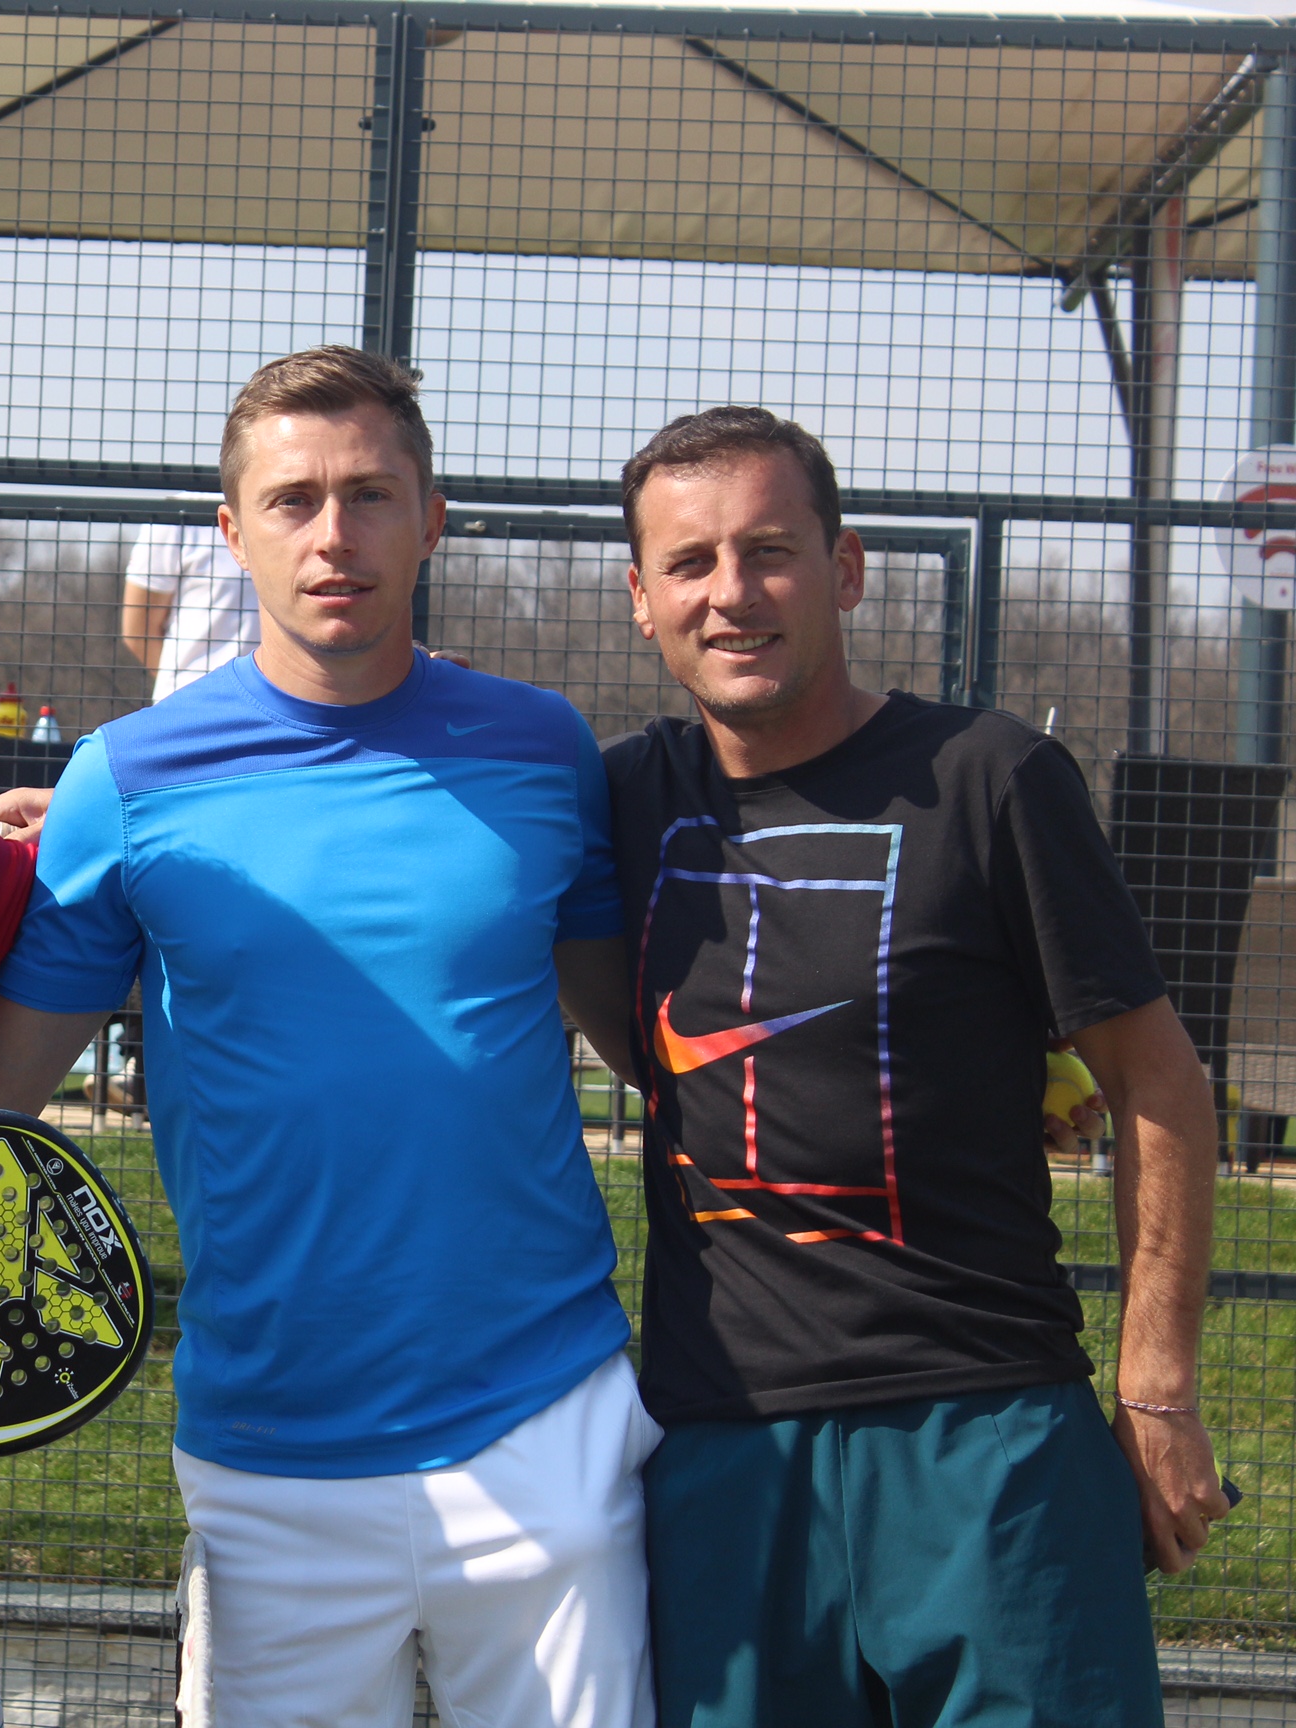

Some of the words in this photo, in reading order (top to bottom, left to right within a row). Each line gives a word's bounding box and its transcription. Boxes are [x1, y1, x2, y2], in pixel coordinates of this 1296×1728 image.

[66, 1194, 83, 1217] makes
[80, 1217, 91, 1232] you
[88, 1231, 108, 1260] improve
[232, 1421, 276, 1435] DRI-FIT
